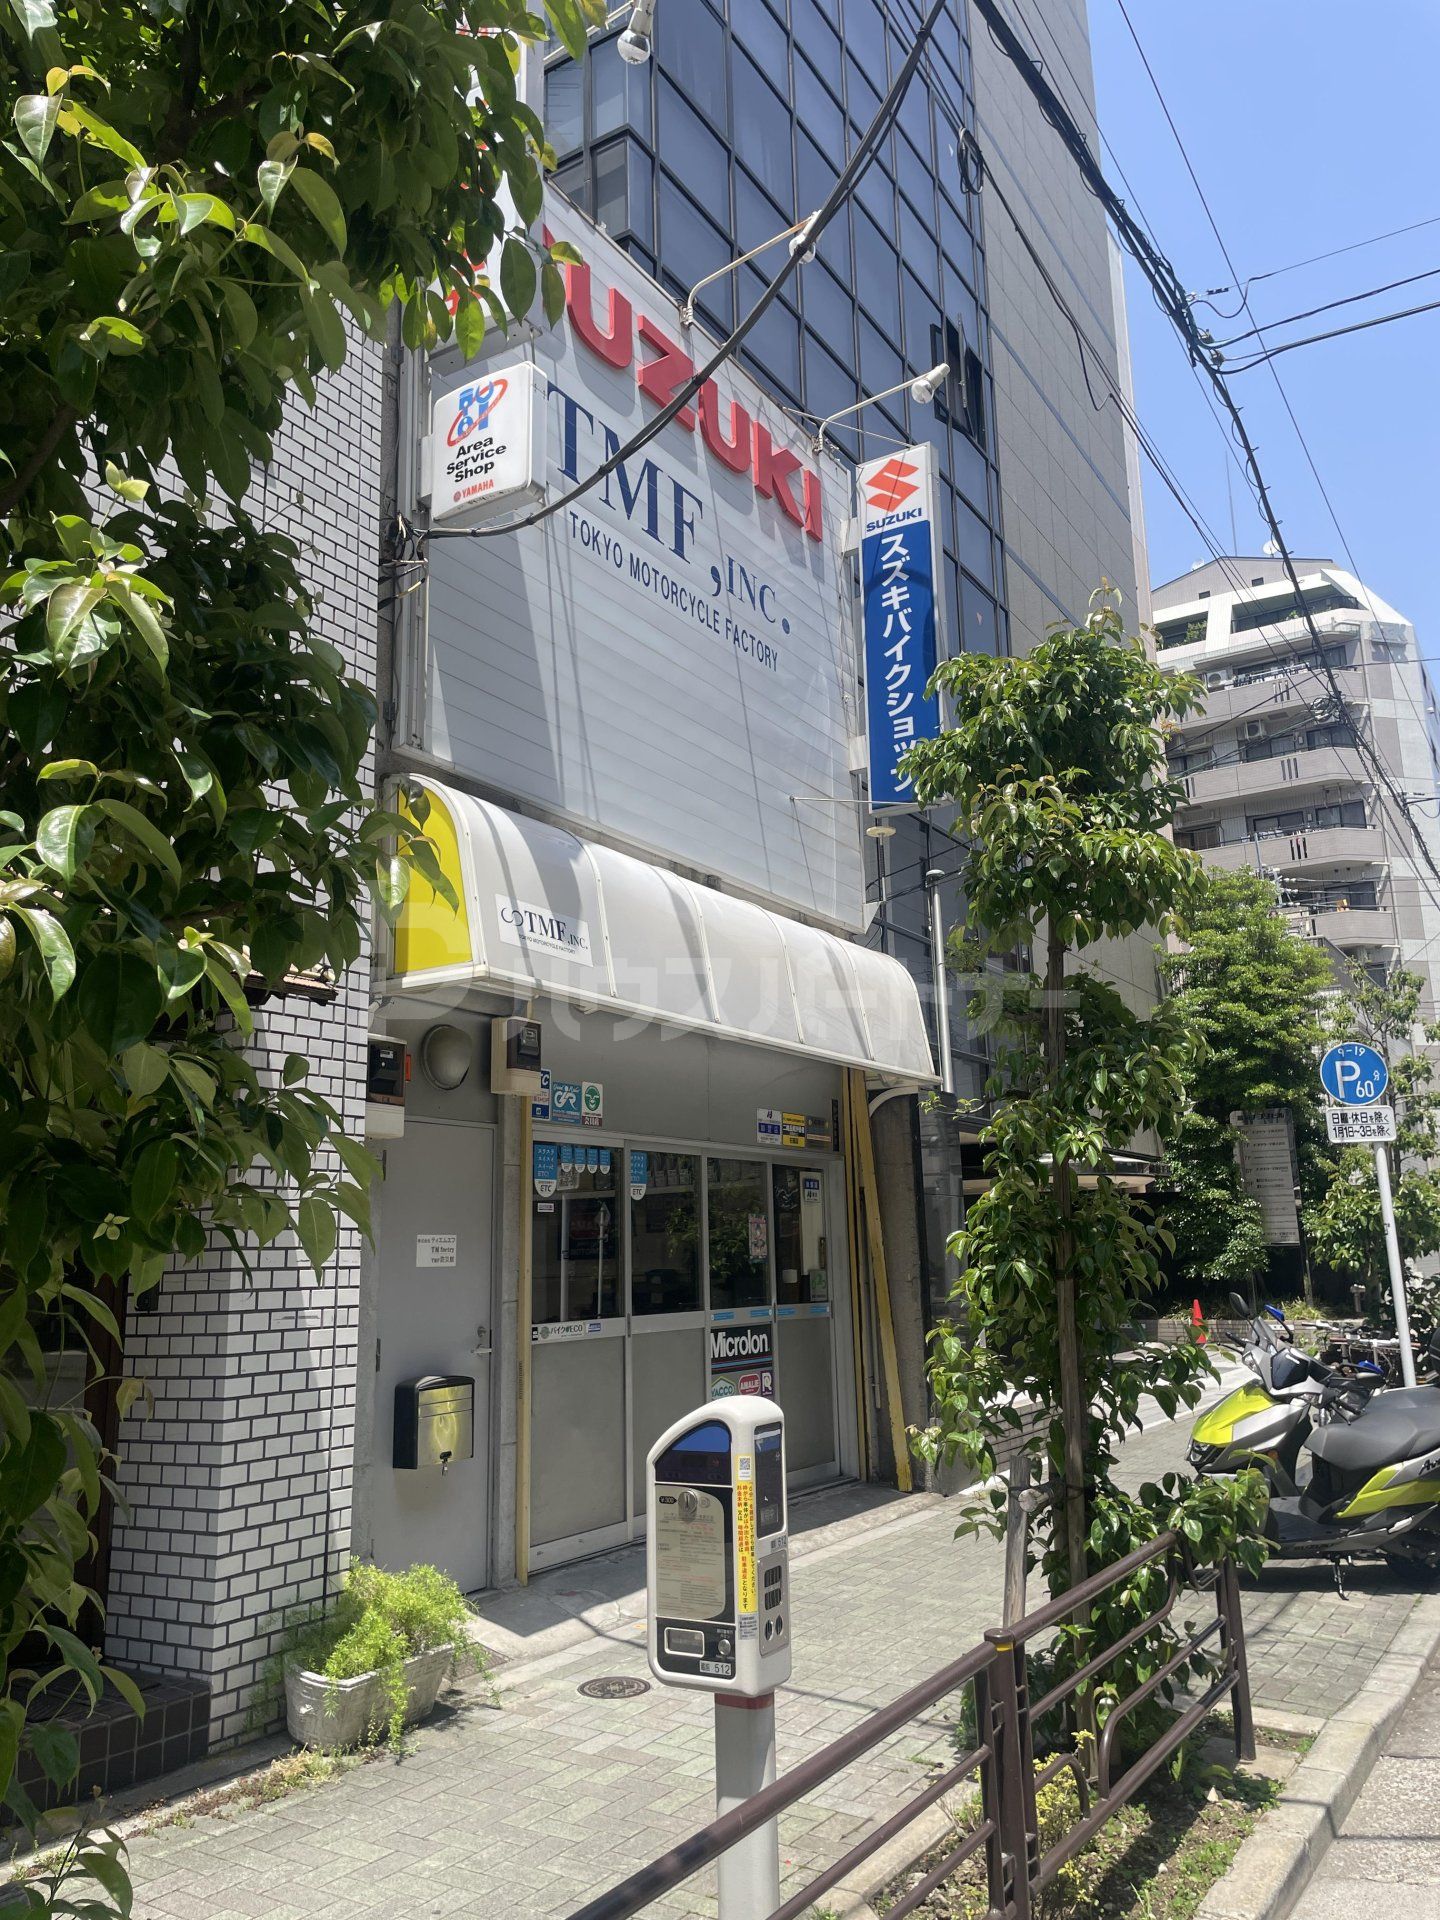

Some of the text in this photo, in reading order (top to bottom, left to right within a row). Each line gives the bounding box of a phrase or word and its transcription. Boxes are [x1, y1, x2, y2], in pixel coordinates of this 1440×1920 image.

[543, 224, 822, 542] UZUKI
[456, 437, 493, 458] Area
[446, 444, 507, 475] Service
[454, 461, 495, 483] Shop
[461, 479, 494, 498] YAMAHA
[866, 507, 922, 533] SUZUKI
[569, 510, 778, 672] TOKYO MOTORCYCLE FACTORY
[1338, 1046, 1366, 1057] 9-19
[1335, 1060, 1361, 1098] P
[540, 1184, 552, 1193] ETC
[632, 1188, 642, 1196] ETC
[711, 1331, 768, 1359] Microlon
[711, 1385, 734, 1397] YACCO
[714, 1663, 730, 1674] 512
